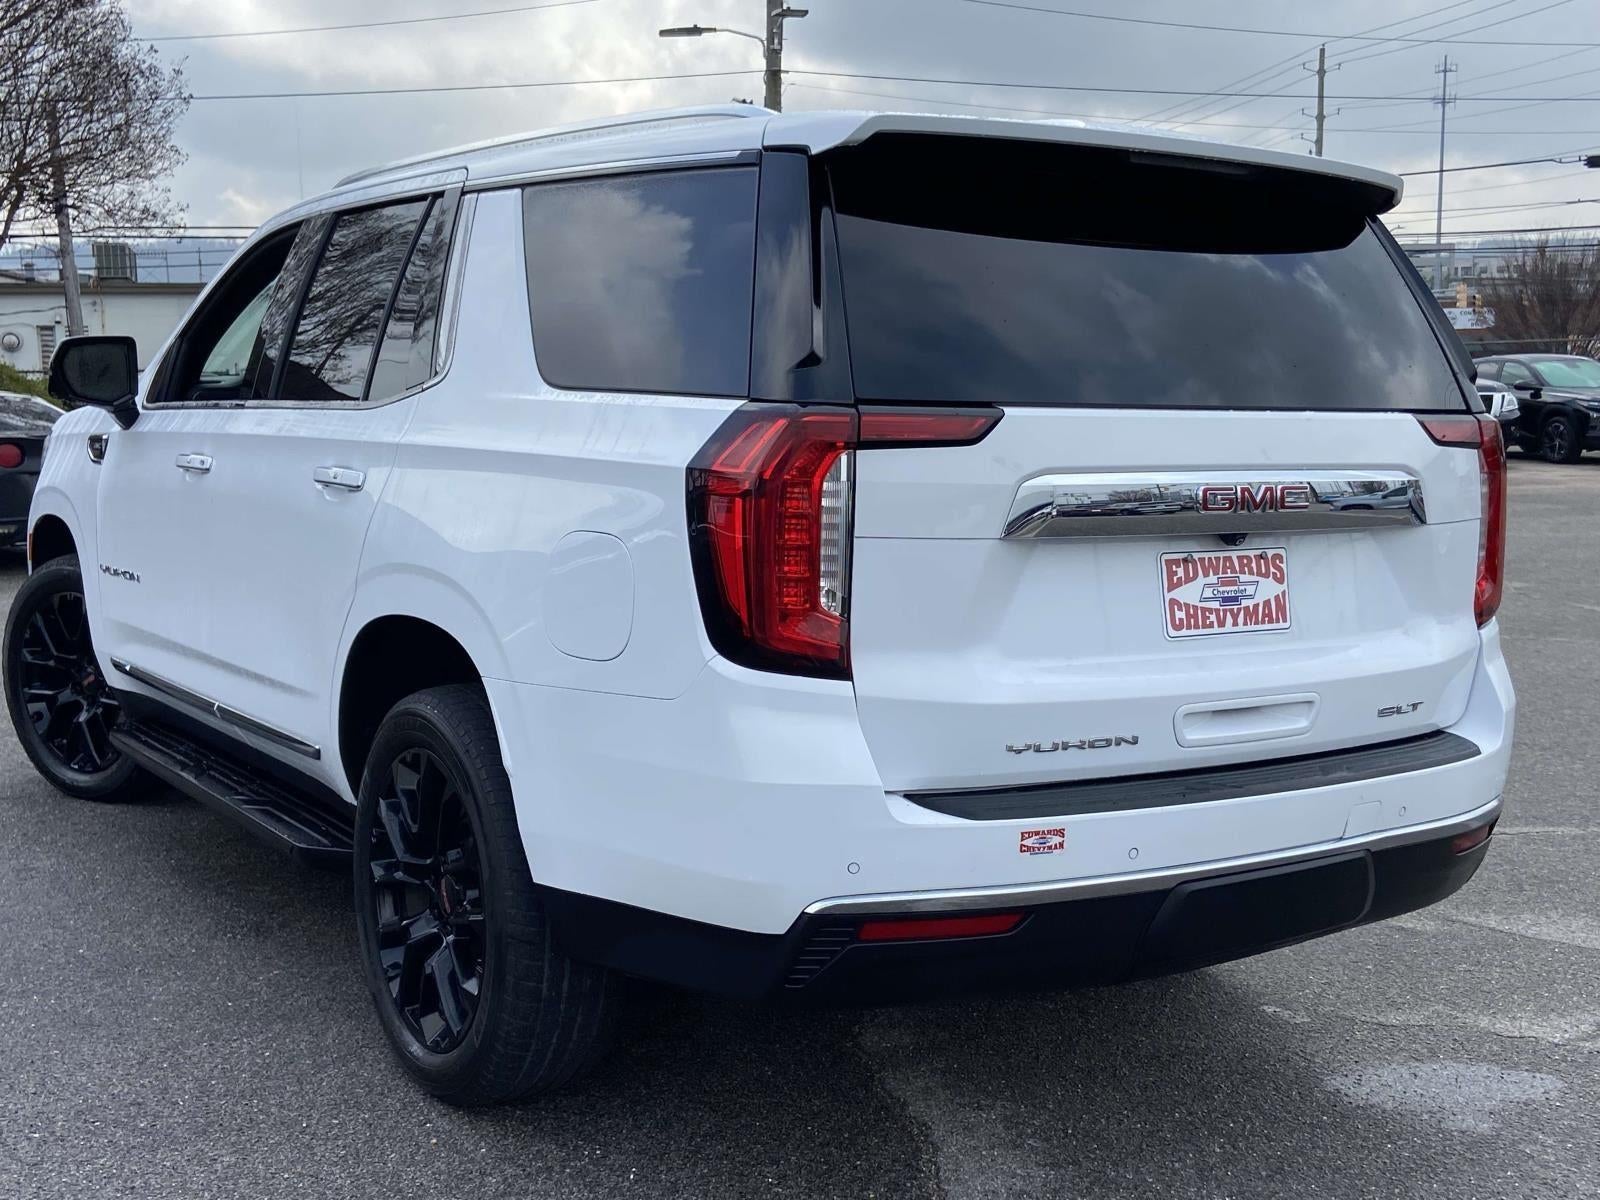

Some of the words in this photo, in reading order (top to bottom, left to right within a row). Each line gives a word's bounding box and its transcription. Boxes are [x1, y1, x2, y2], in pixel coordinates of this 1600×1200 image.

[1198, 484, 1310, 513] GMC
[1165, 553, 1286, 594] EDWARDS
[1211, 587, 1248, 597] Chevrolet
[1168, 590, 1288, 632] CHEVYMAN
[1377, 700, 1425, 718] SLT
[1005, 735, 1140, 755] YUKON
[1020, 827, 1066, 842] EDWARDS
